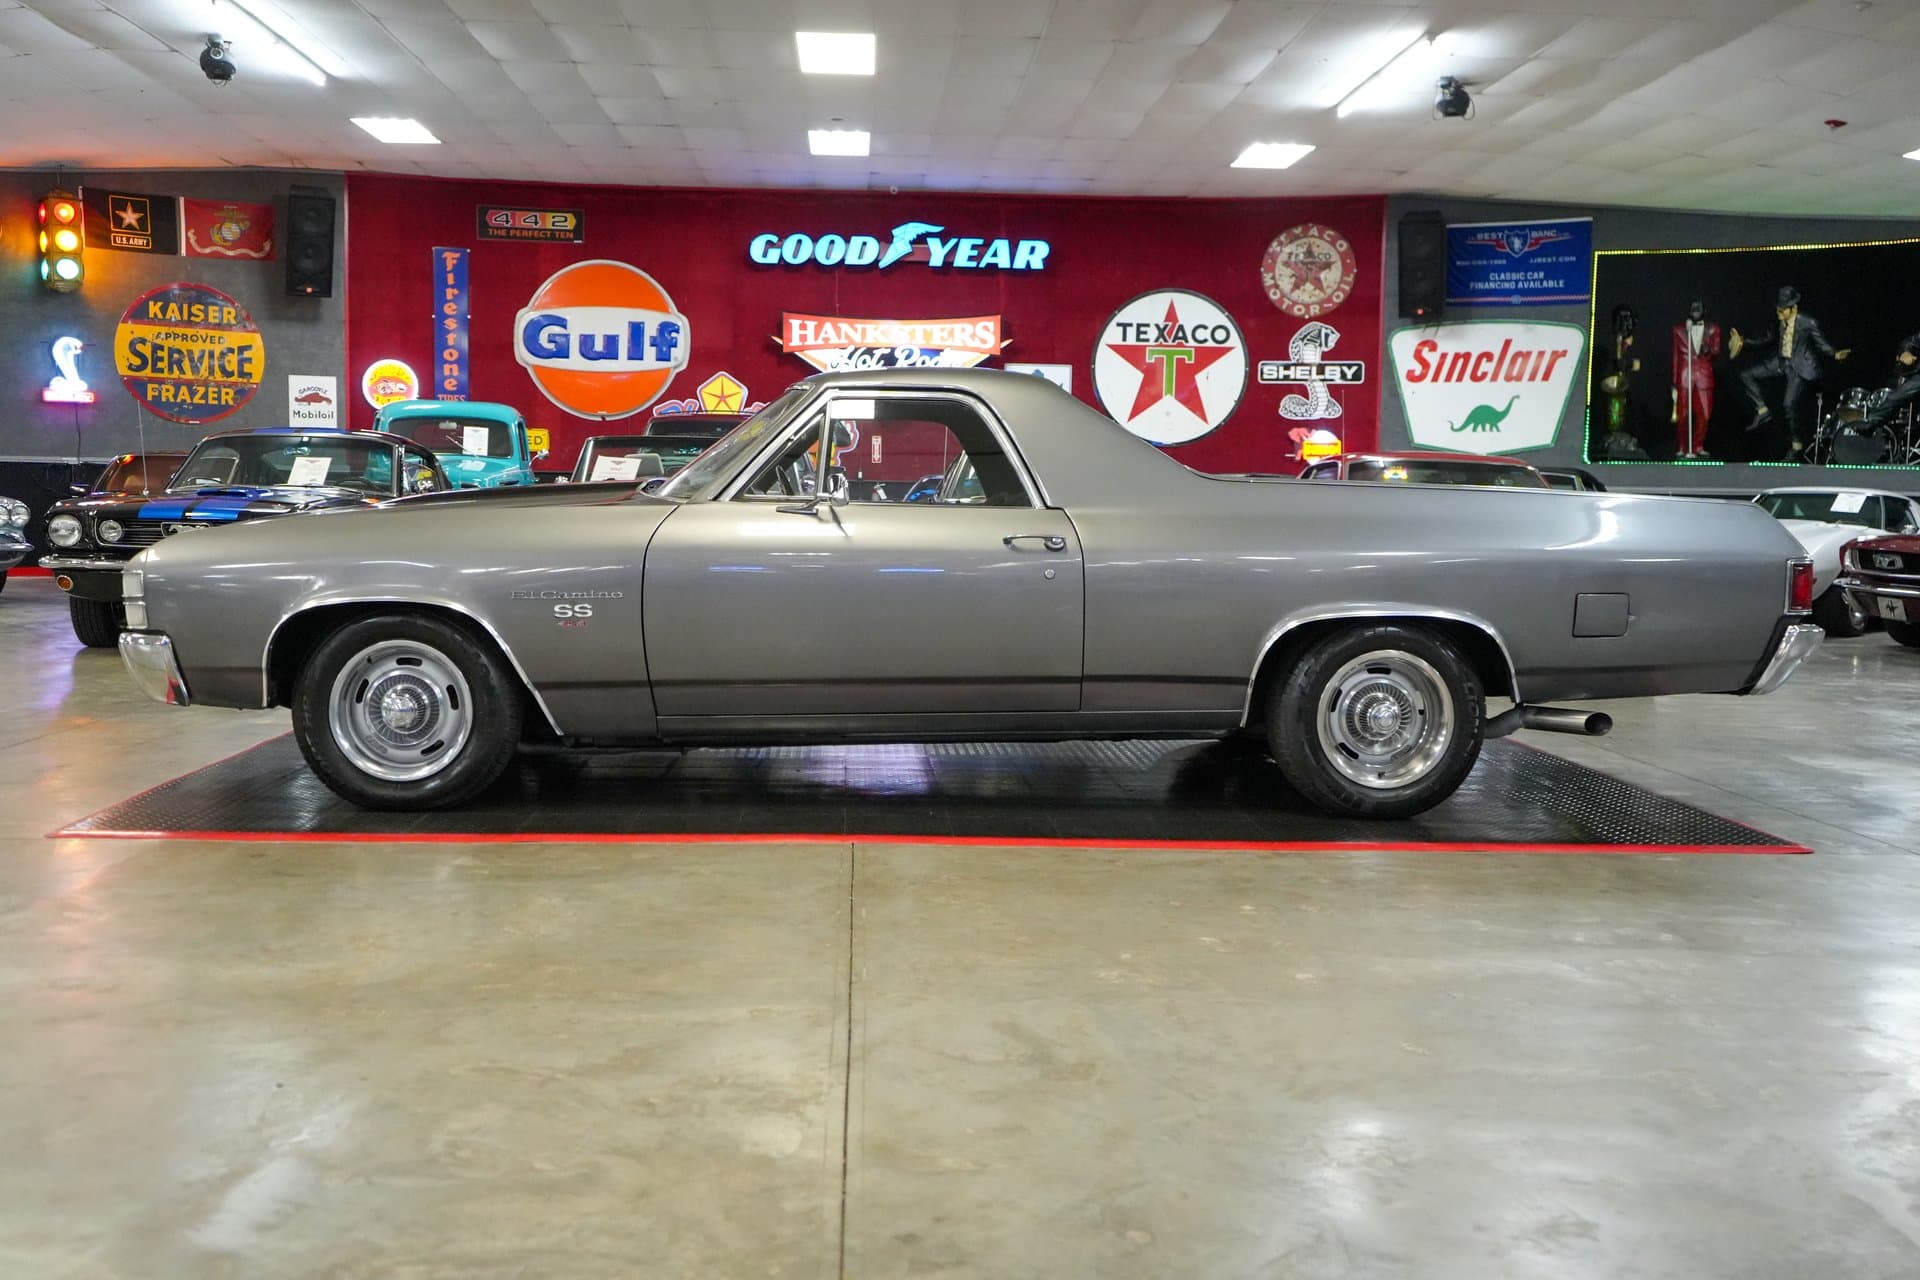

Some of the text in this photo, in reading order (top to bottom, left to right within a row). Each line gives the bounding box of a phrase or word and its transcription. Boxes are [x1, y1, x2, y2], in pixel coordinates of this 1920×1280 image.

[115, 236, 148, 247] U.S. ARMY
[487, 228, 575, 239] THE PERFECT TEN
[1469, 279, 1565, 290] FINANCING AVAILABLE
[1489, 271, 1545, 281] CLASSIC CAR
[1263, 272, 1355, 316] MOTOR OIL
[148, 300, 237, 325] KAISER
[442, 251, 461, 391] Firestone
[154, 331, 227, 345] APPROVED
[522, 313, 681, 362] Gulf
[788, 318, 996, 350] HANKSTERS
[1116, 321, 1231, 346] TEXACO
[127, 336, 254, 379] SERVICE
[1405, 338, 1569, 383] Sinclair
[1262, 365, 1360, 381] SHELBY
[146, 383, 236, 406] FRAZER
[292, 410, 334, 419] Mobiloil
[553, 603, 593, 618] SS
